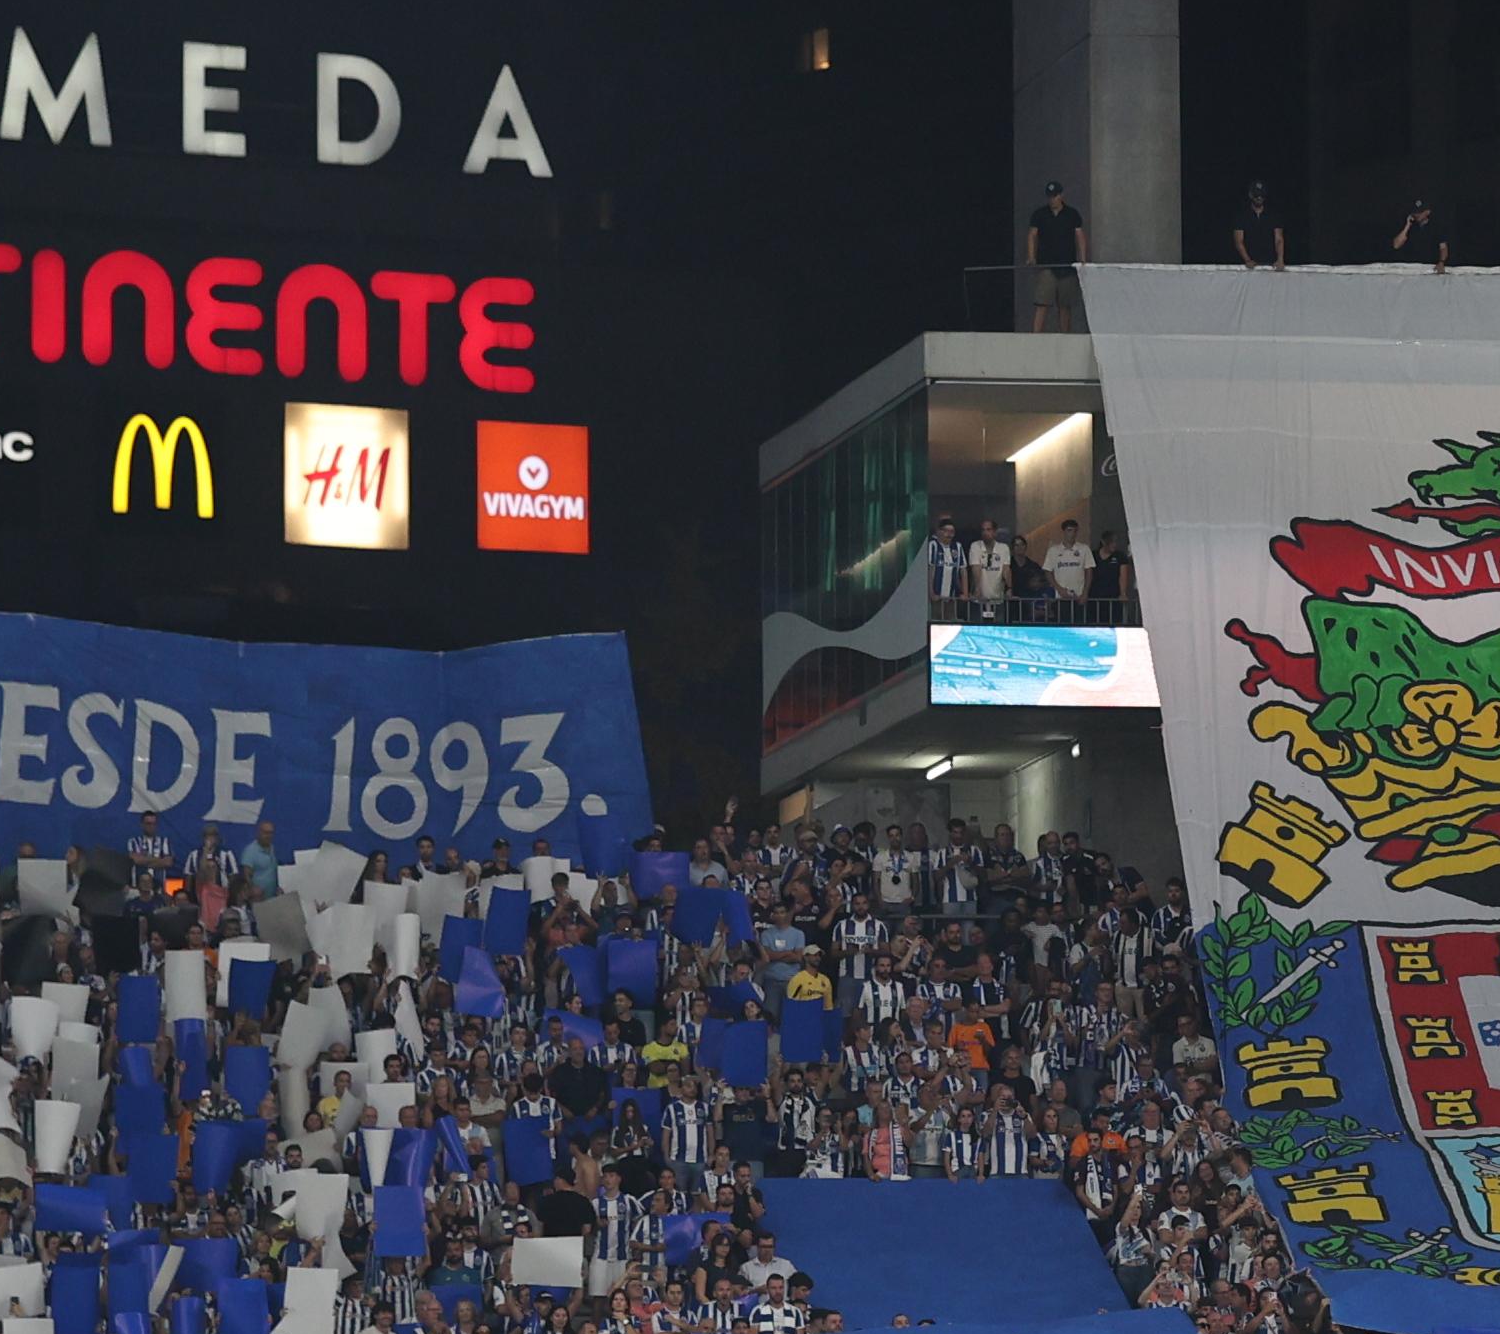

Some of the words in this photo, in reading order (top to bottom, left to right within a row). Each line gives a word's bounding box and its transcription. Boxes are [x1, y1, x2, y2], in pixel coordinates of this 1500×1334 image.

[303, 444, 391, 512] H&M
[483, 490, 585, 521] VIVAGYM
[323, 710, 608, 840] 1893.
